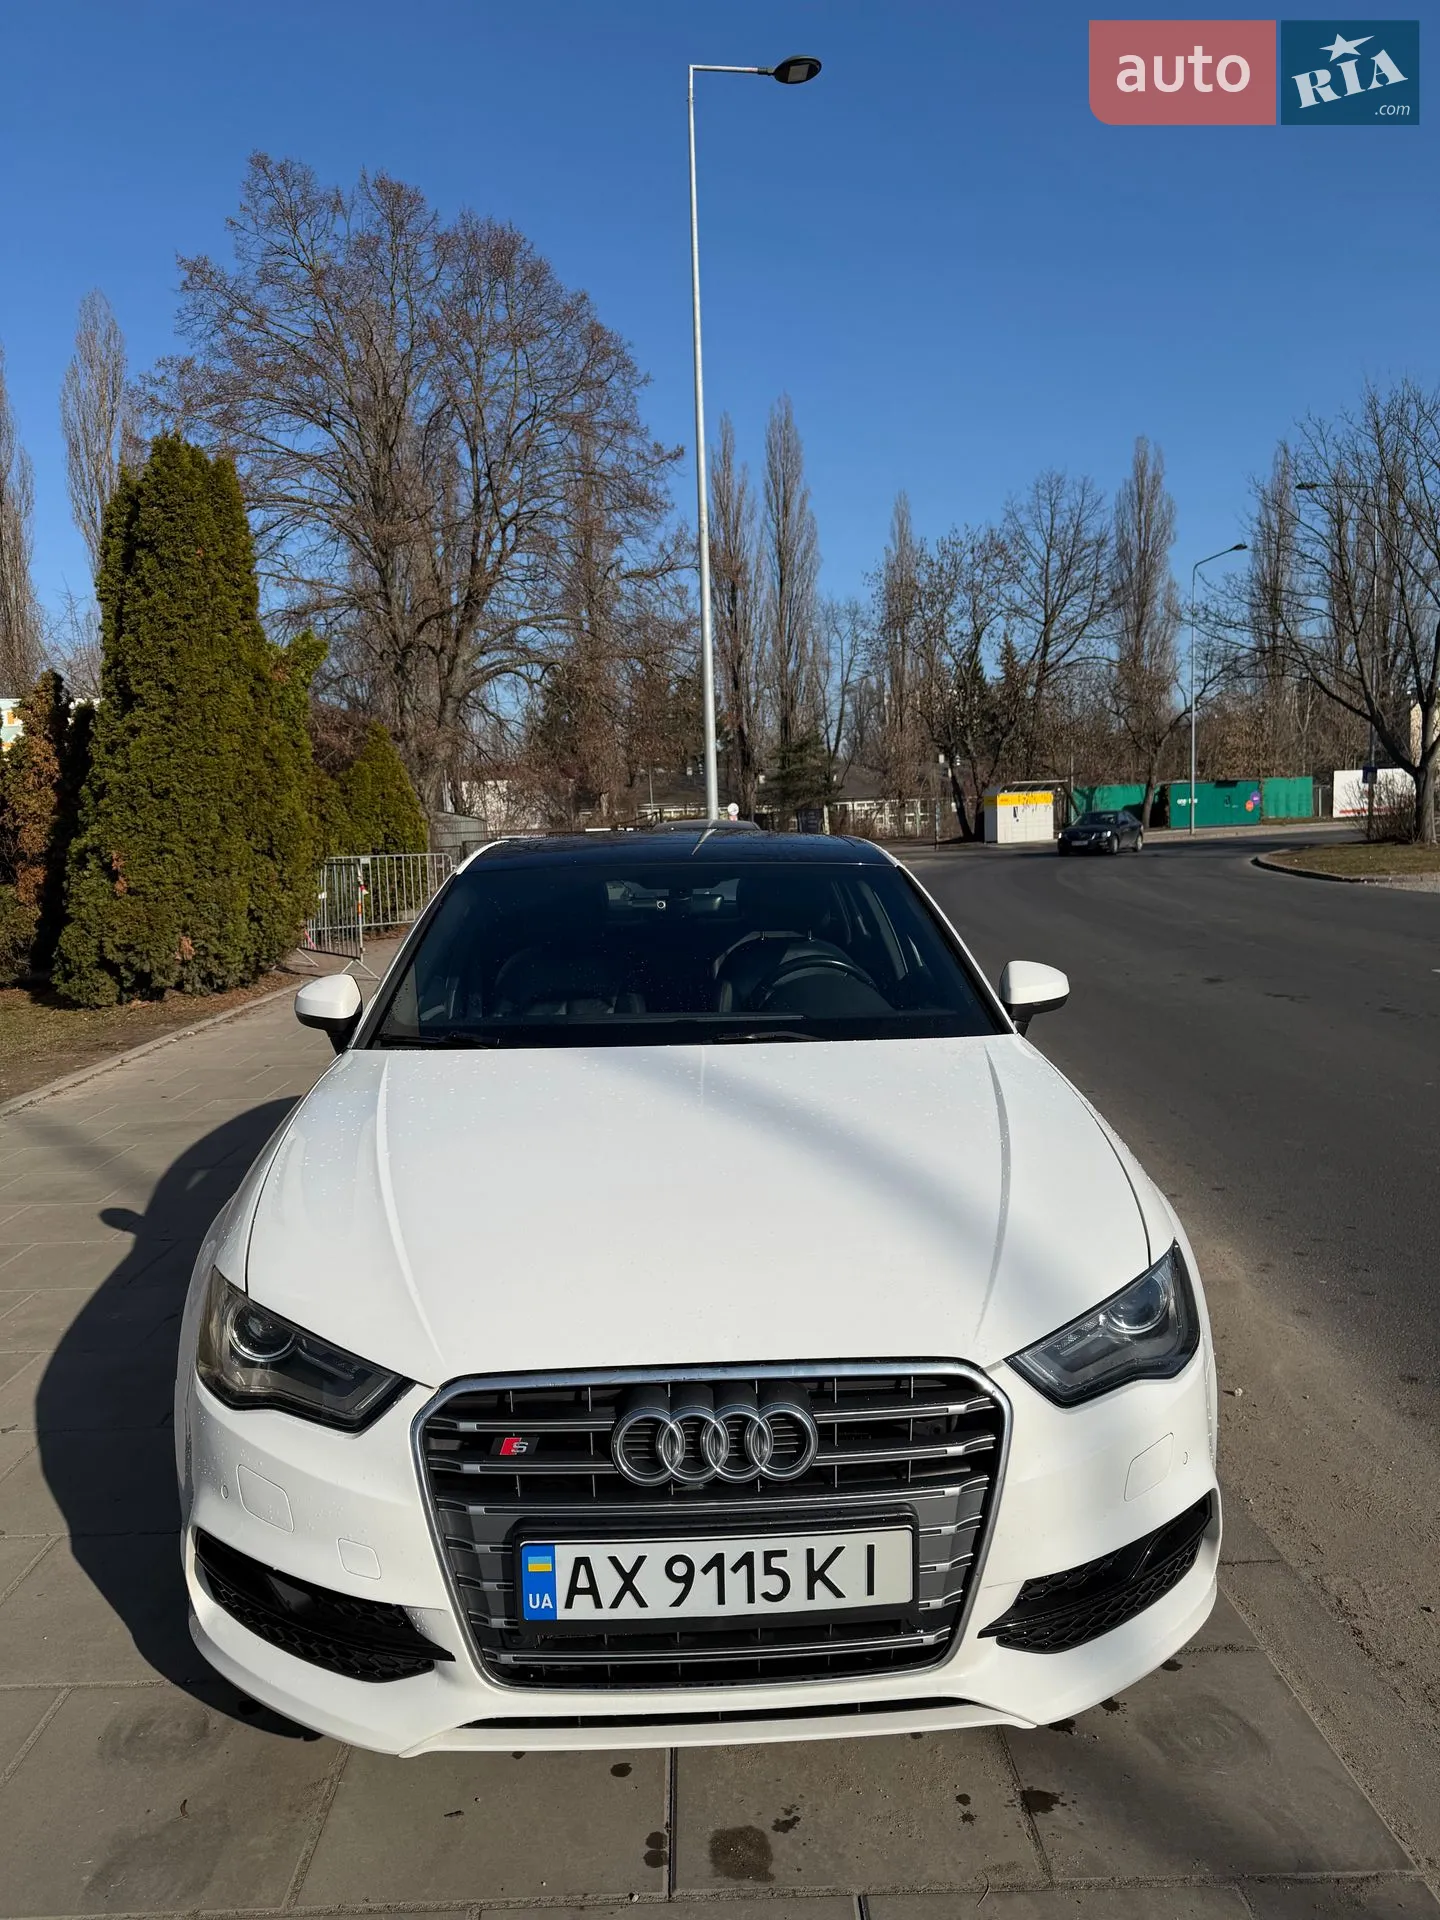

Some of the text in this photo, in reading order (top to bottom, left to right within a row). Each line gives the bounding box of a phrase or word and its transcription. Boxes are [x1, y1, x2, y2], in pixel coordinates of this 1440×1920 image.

[564, 1554, 649, 1609] AX
[664, 1548, 792, 1608] 9115
[528, 1593, 554, 1610] UA
